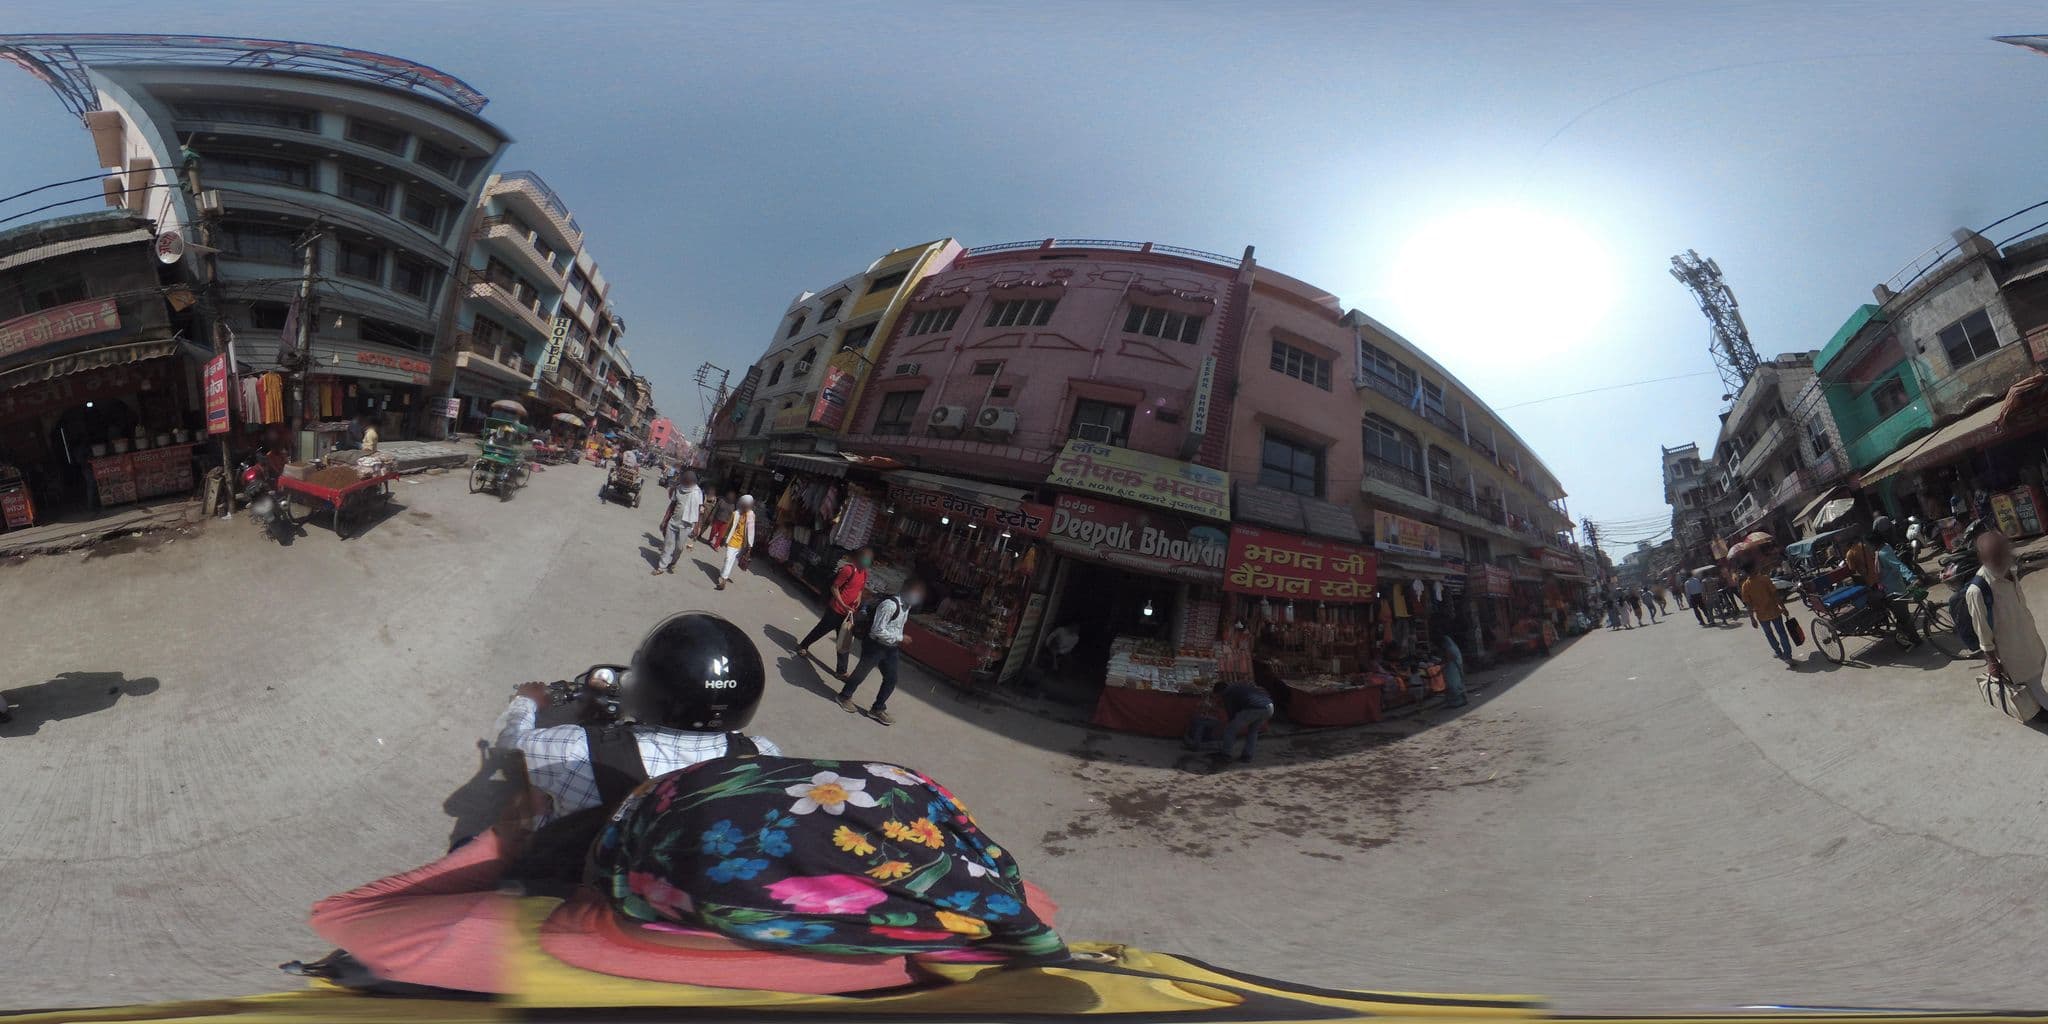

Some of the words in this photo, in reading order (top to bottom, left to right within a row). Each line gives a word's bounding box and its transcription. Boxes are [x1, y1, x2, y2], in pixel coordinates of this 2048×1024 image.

[546, 319, 569, 365] HOTEL
[1060, 454, 1148, 487] दीपक
[1152, 476, 1223, 505] भवन
[1088, 481, 1115, 492] NON
[1059, 496, 1095, 514] Lodge
[1050, 509, 1134, 551] Deepak
[1139, 526, 1227, 568] Bhawan
[1244, 544, 1325, 571] भगत
[1329, 553, 1368, 577] जी
[1229, 561, 1313, 594] बैंगल
[1319, 577, 1376, 599] स्टोर
